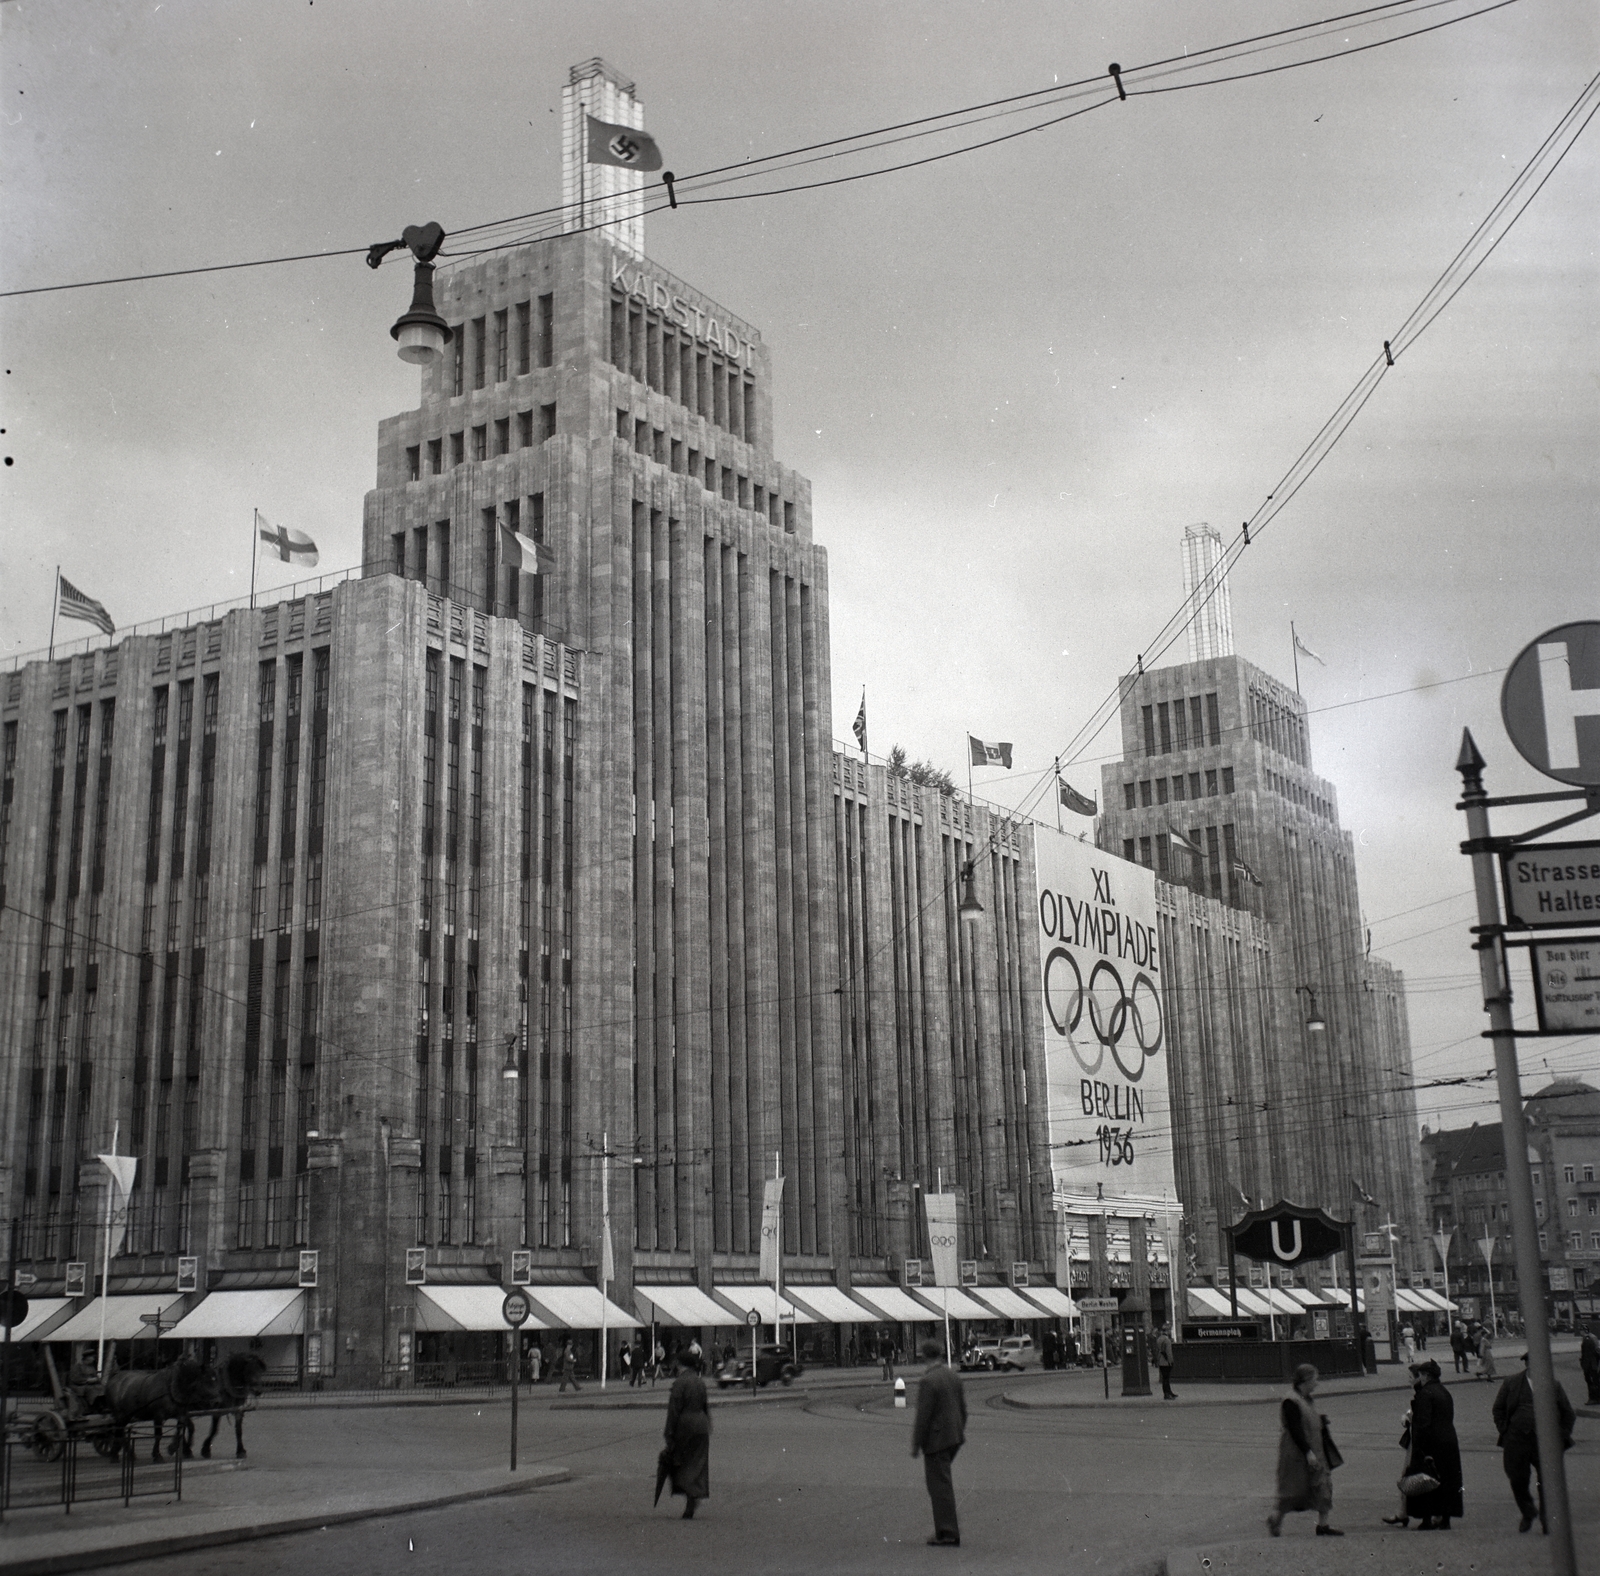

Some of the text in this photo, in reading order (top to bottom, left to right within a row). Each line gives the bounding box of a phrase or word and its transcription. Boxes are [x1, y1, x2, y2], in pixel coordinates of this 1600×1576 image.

[612, 254, 756, 370] KARSTADT
[1538, 641, 1600, 770] H
[1090, 867, 1116, 906] XI.
[1517, 861, 1600, 884] Strasse
[1040, 888, 1159, 972] OLYMPIADE
[1080, 1078, 1144, 1124] BERLIN
[1095, 1124, 1135, 1168] 1936
[1270, 1219, 1303, 1261] U
